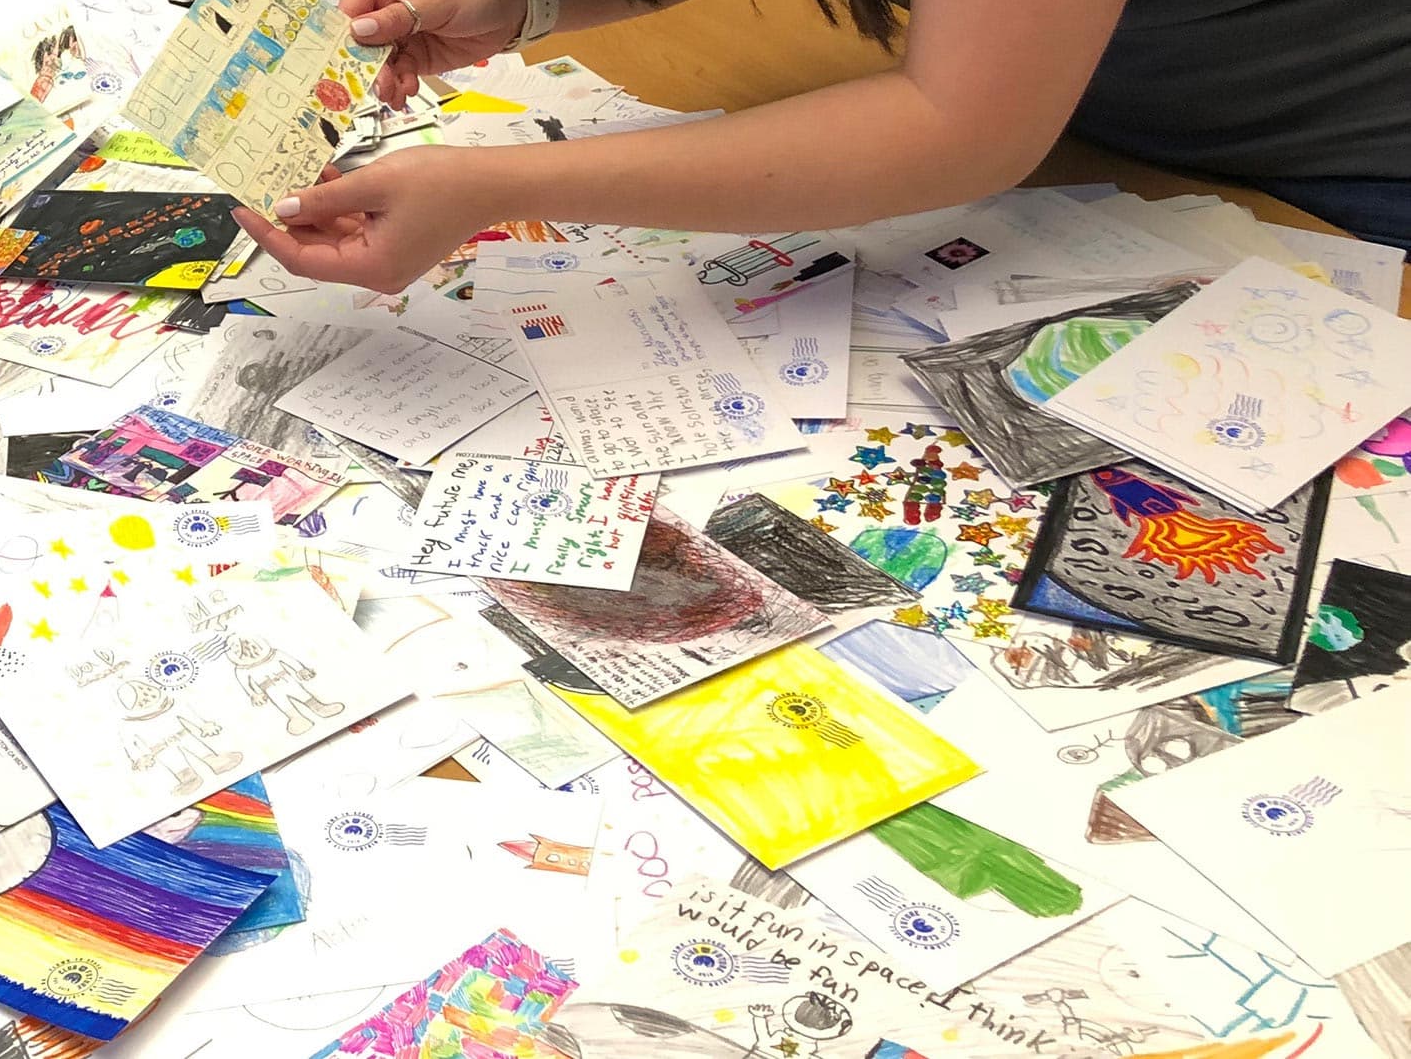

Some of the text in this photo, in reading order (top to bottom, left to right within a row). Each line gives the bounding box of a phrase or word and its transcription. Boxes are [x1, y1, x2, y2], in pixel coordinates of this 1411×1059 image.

[216, 36, 325, 187] ORIGIN
[276, 452, 330, 479] WORKING
[424, 483, 461, 529] future
[448, 464, 494, 569] I must have a
[466, 473, 513, 569] truck and a
[587, 515, 610, 526] I
[410, 537, 452, 567] Hey
[490, 540, 511, 573] nice
[506, 499, 525, 526] car
[509, 560, 531, 574] I
[523, 514, 547, 550] must
[546, 536, 581, 576] really
[605, 529, 625, 549] hot
[602, 560, 615, 570] a
[678, 903, 859, 1003] would be fun
[689, 884, 716, 903] is
[718, 894, 747, 921] it
[752, 911, 804, 942] fun
[808, 932, 838, 959] in
[967, 1001, 1056, 1054] think
